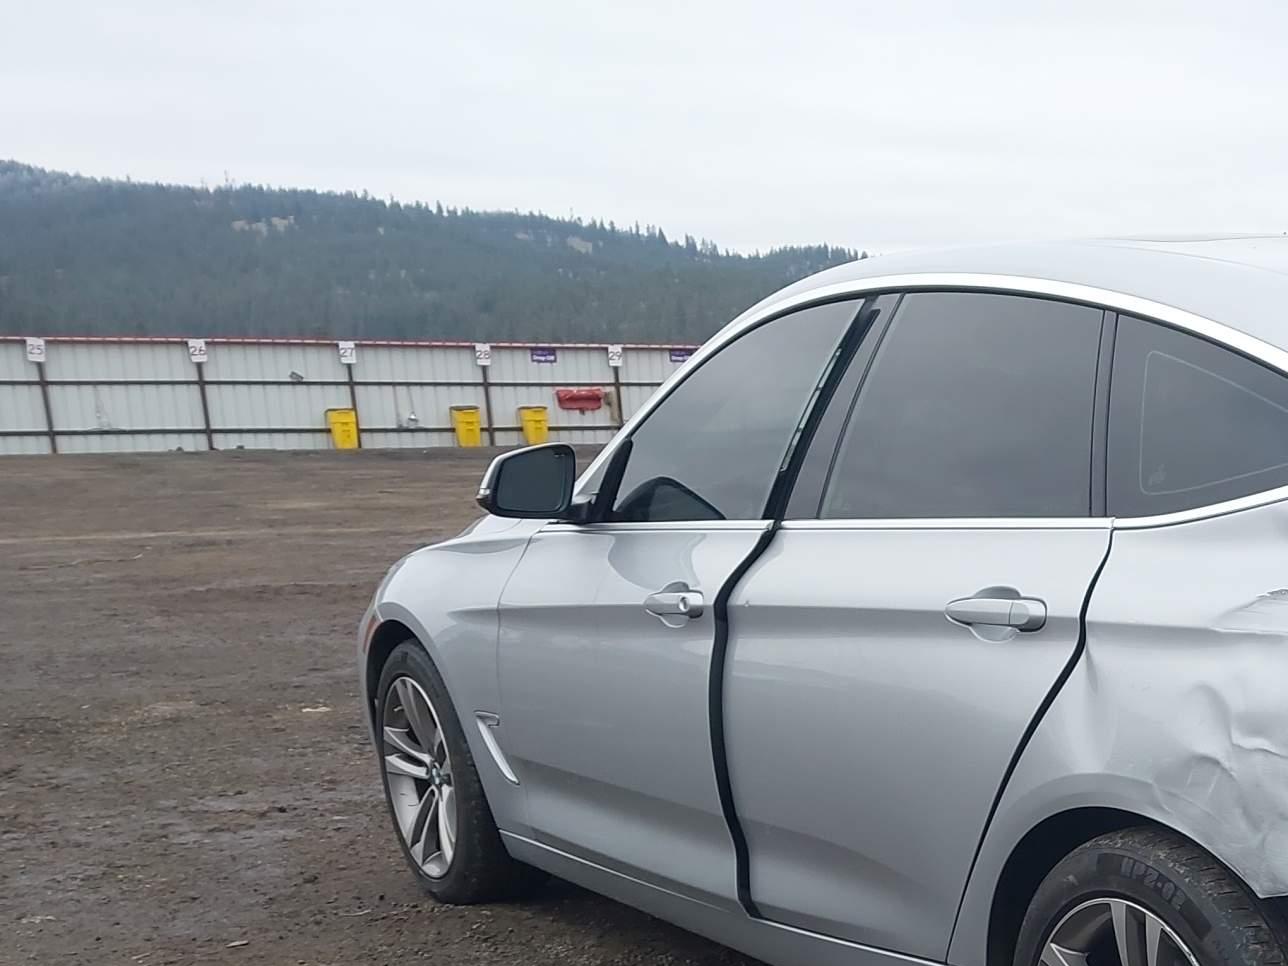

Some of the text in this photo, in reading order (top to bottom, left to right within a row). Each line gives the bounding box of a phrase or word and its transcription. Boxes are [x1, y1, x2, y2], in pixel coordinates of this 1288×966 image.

[28, 344, 44, 355] 25
[190, 345, 206, 356] 26
[339, 347, 354, 357] 27
[476, 350, 491, 360] 28
[608, 351, 622, 361] 29
